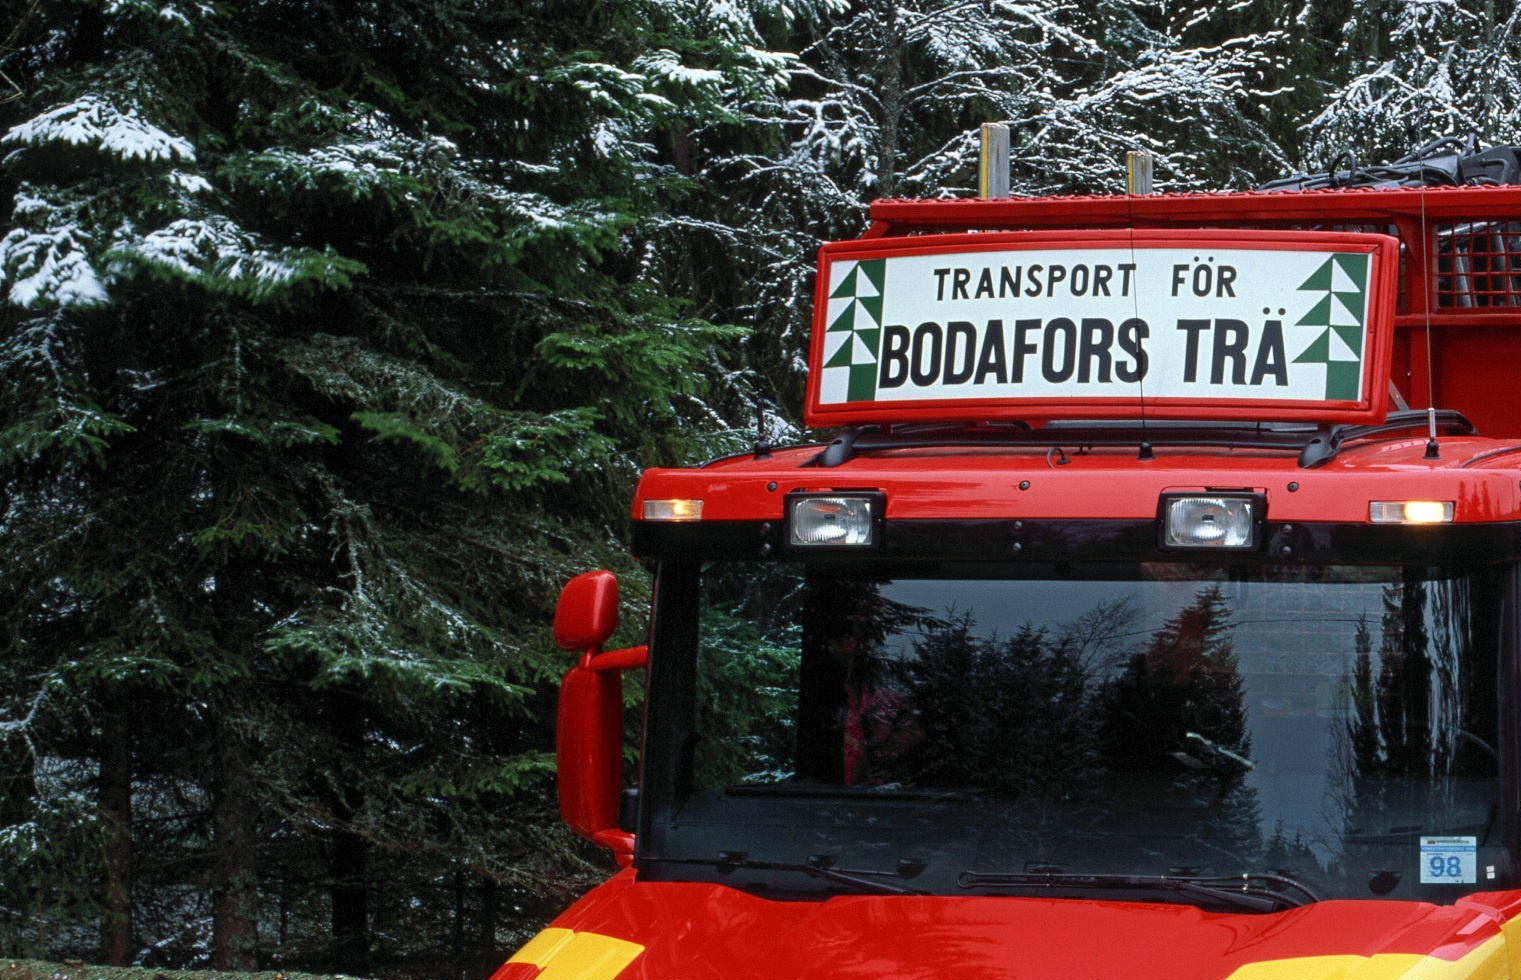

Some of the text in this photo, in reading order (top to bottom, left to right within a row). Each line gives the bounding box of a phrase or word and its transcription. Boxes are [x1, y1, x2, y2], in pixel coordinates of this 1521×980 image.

[934, 256, 1237, 301] TRANSPORT FÖR
[879, 307, 1289, 389] BODAFORS TRÄ
[1430, 855, 1462, 877] 98
